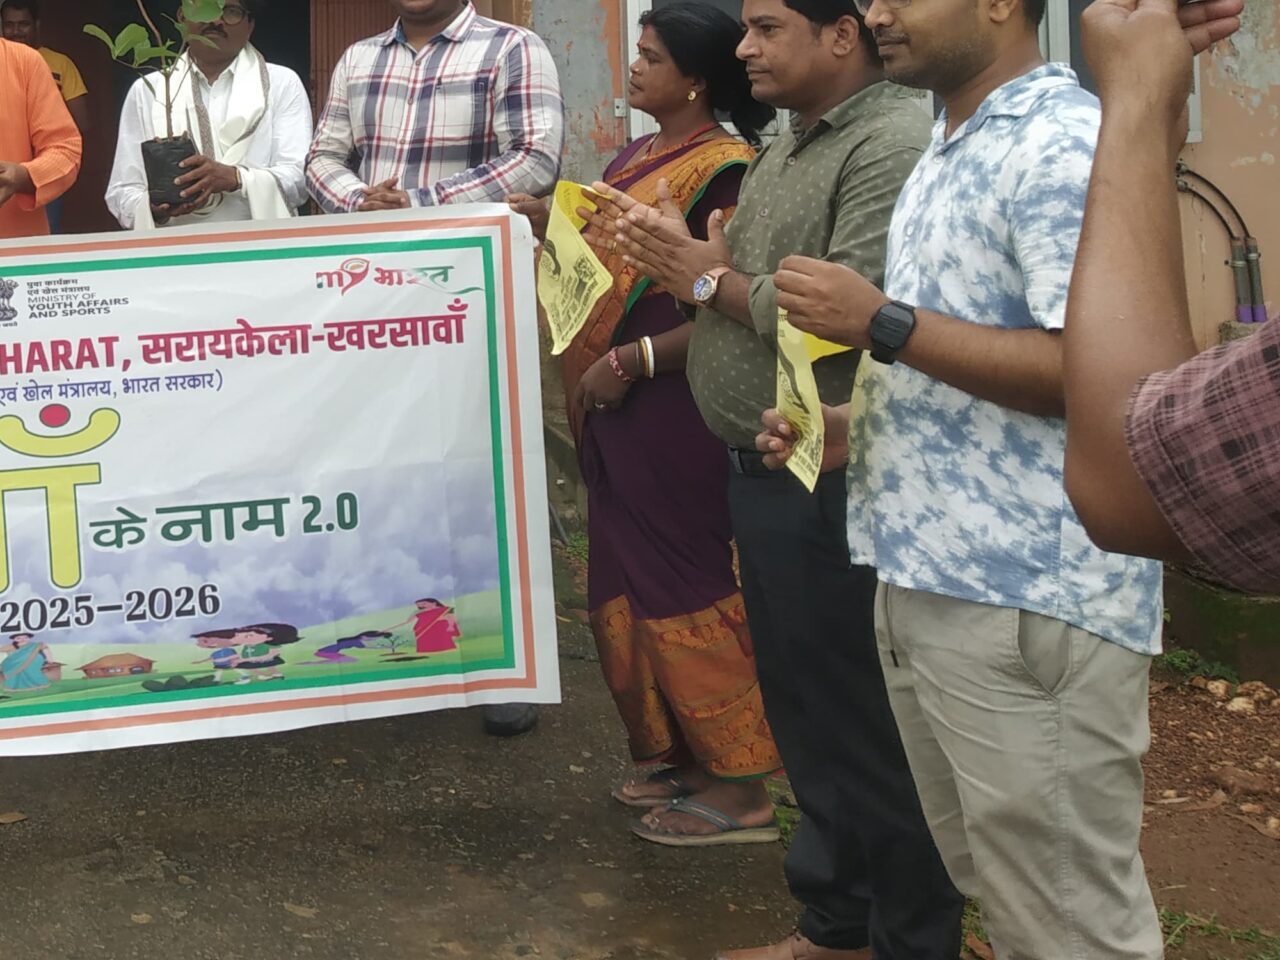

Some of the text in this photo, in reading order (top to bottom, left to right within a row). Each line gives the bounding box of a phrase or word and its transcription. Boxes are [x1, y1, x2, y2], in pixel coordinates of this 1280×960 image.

[28, 292, 97, 304] MINISTRY OF
[28, 297, 129, 312] YOUTH AFFAIRS
[28, 306, 111, 319] AND SPORTS
[122, 375, 161, 395] भारत
[164, 369, 224, 392] सरकार)
[90, 491, 359, 549] के नाम 2.0
